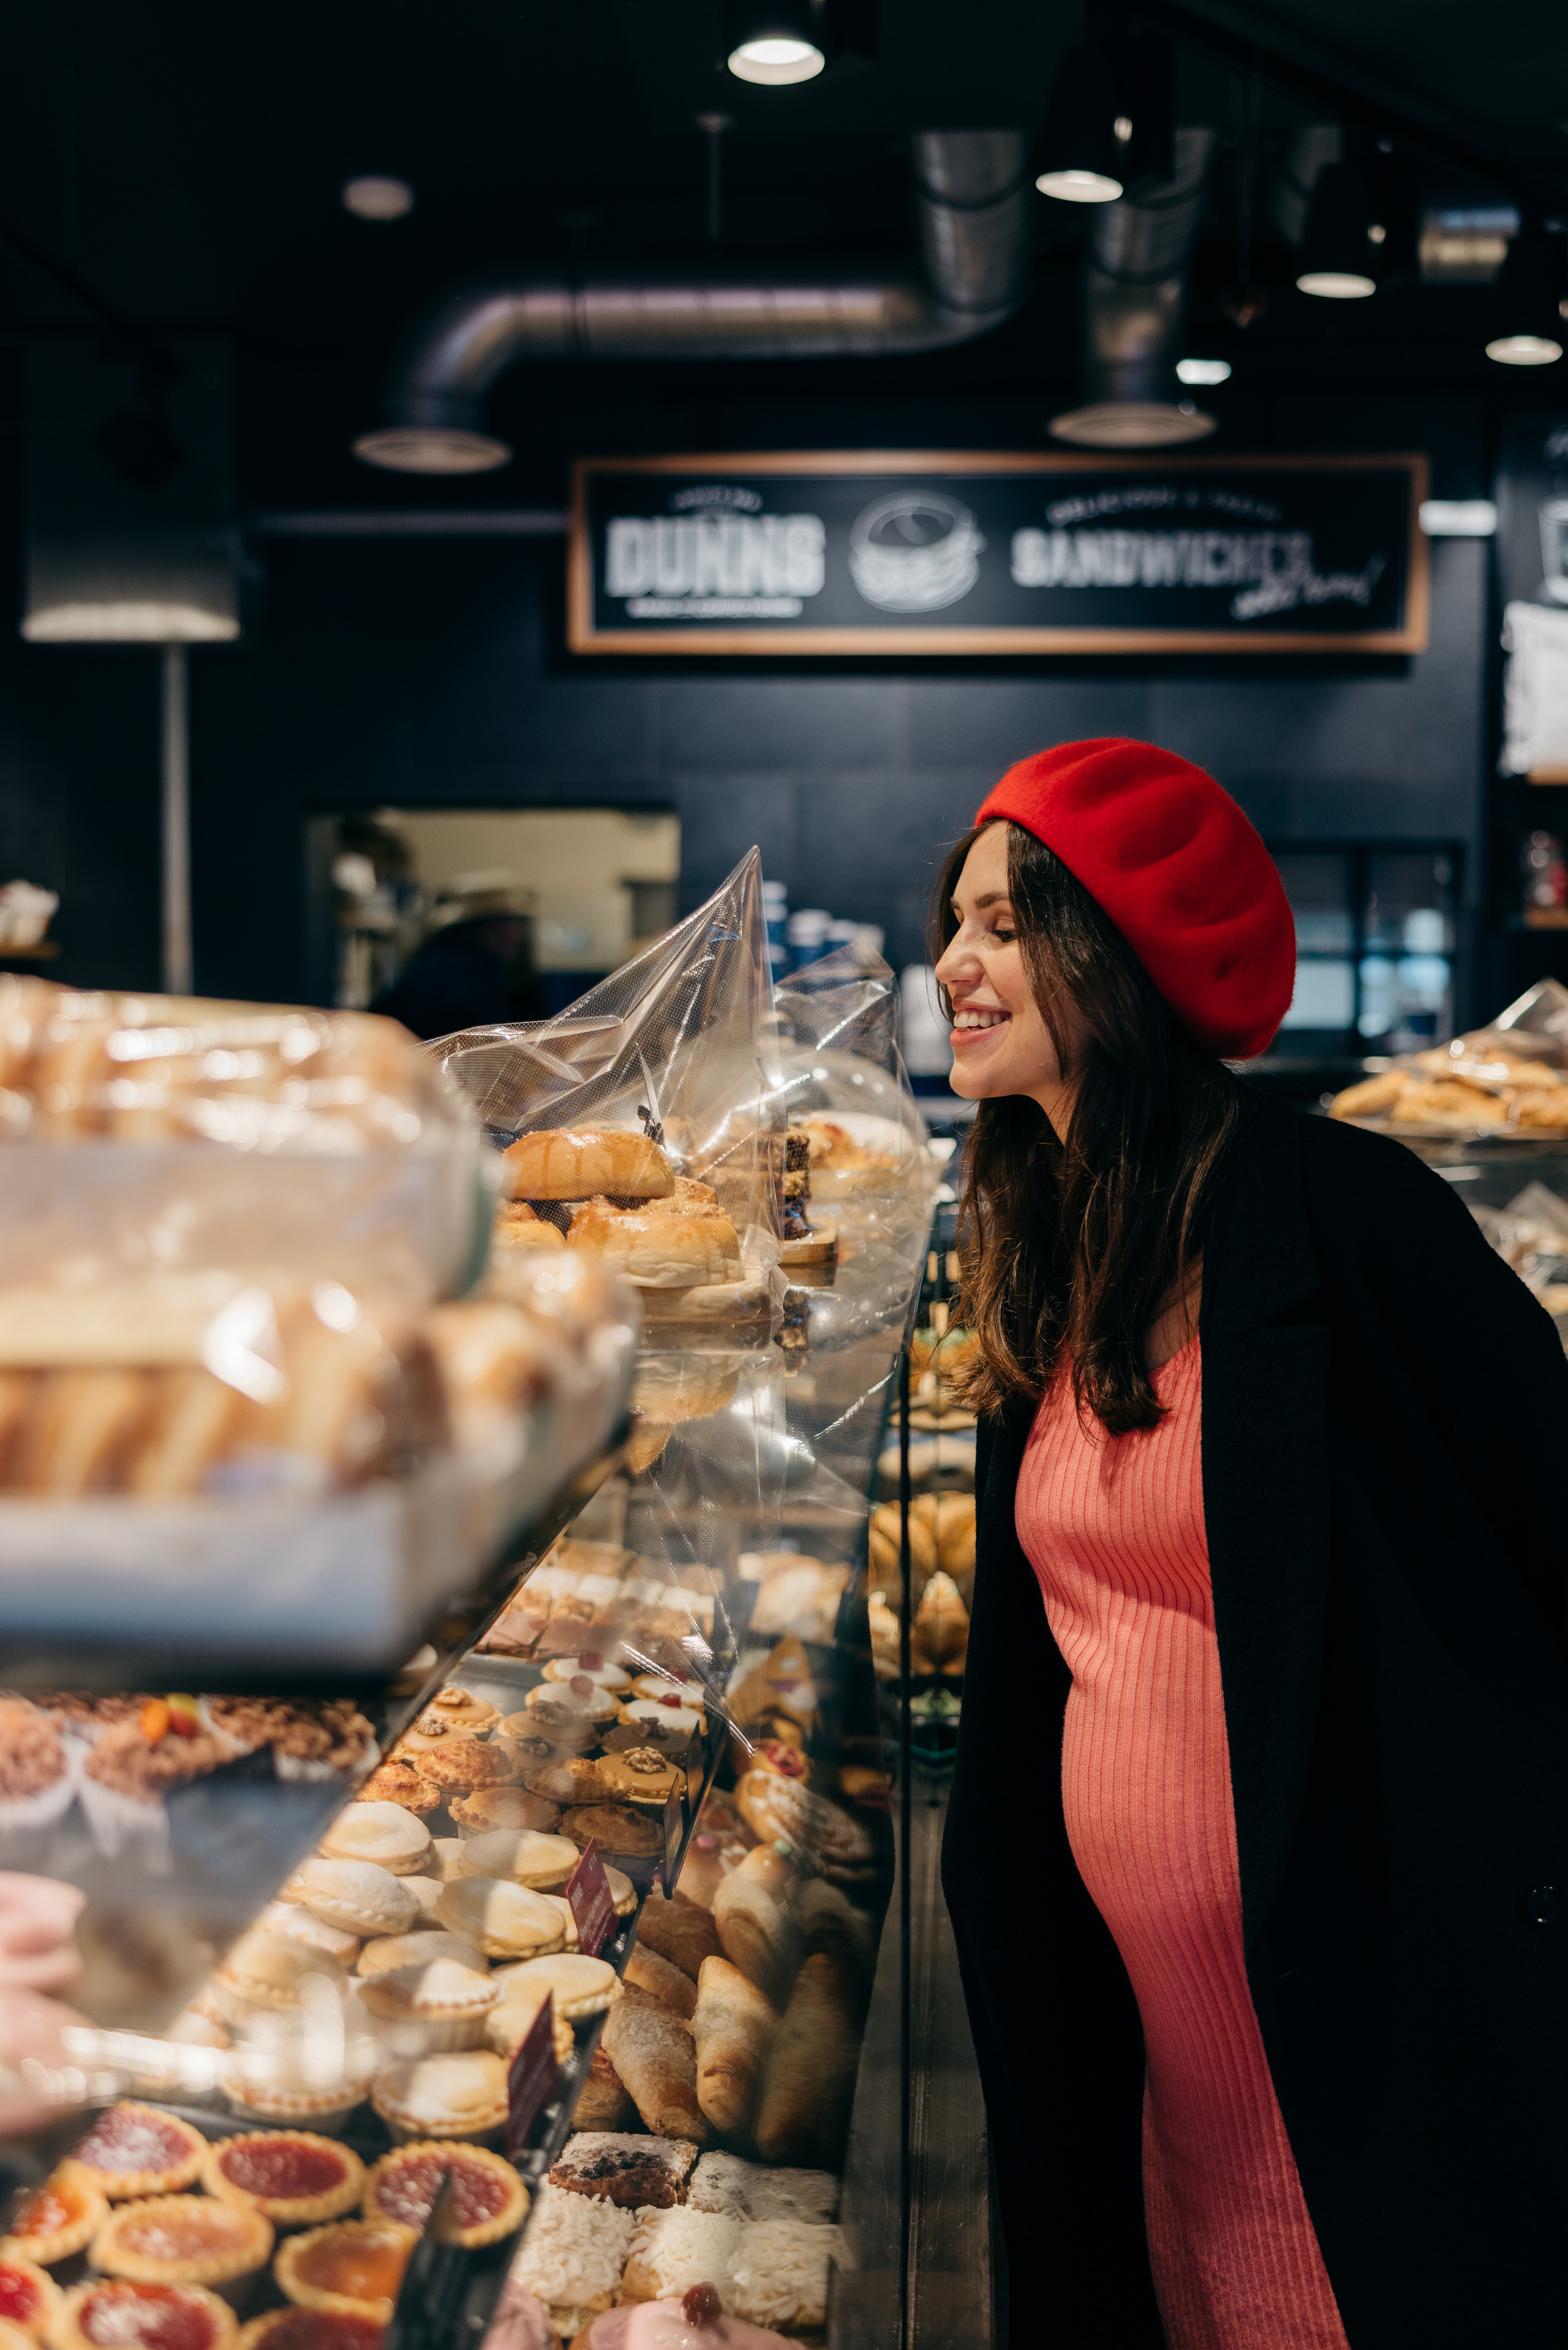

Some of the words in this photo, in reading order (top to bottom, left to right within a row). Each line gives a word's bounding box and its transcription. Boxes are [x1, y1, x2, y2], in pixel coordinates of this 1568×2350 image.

[606, 515, 825, 596] DUNNS
[1011, 529, 1313, 587] SANDWICHES
[571, 1882, 583, 1911] DUNNS
[579, 1905, 596, 1941] Shortcrust
[594, 1889, 604, 1909] Mince
